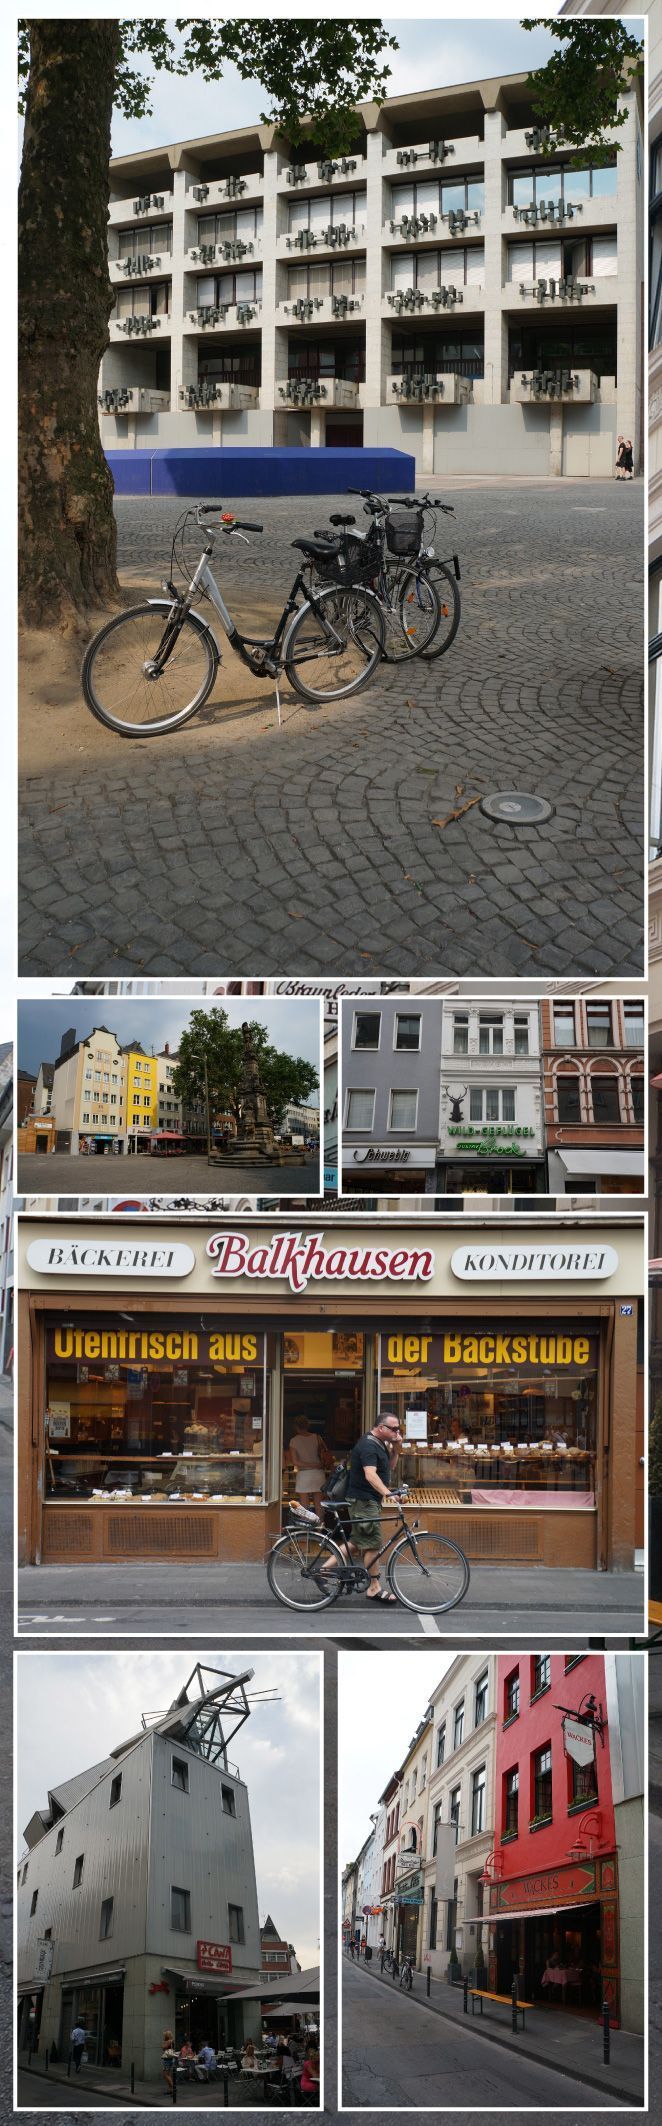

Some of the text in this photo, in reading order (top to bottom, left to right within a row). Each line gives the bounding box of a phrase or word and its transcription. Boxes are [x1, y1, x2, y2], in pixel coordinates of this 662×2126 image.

[46, 1245, 178, 1268] BÄCKEREI
[207, 1234, 433, 1290] Balkhausen
[464, 1252, 608, 1272] KONDITOREI
[621, 1305, 633, 1315] 27
[209, 1333, 257, 1360] aus
[387, 1334, 590, 1364] der Backstube
[567, 1731, 592, 1746] WACKES
[523, 1876, 559, 1895] WACKES
